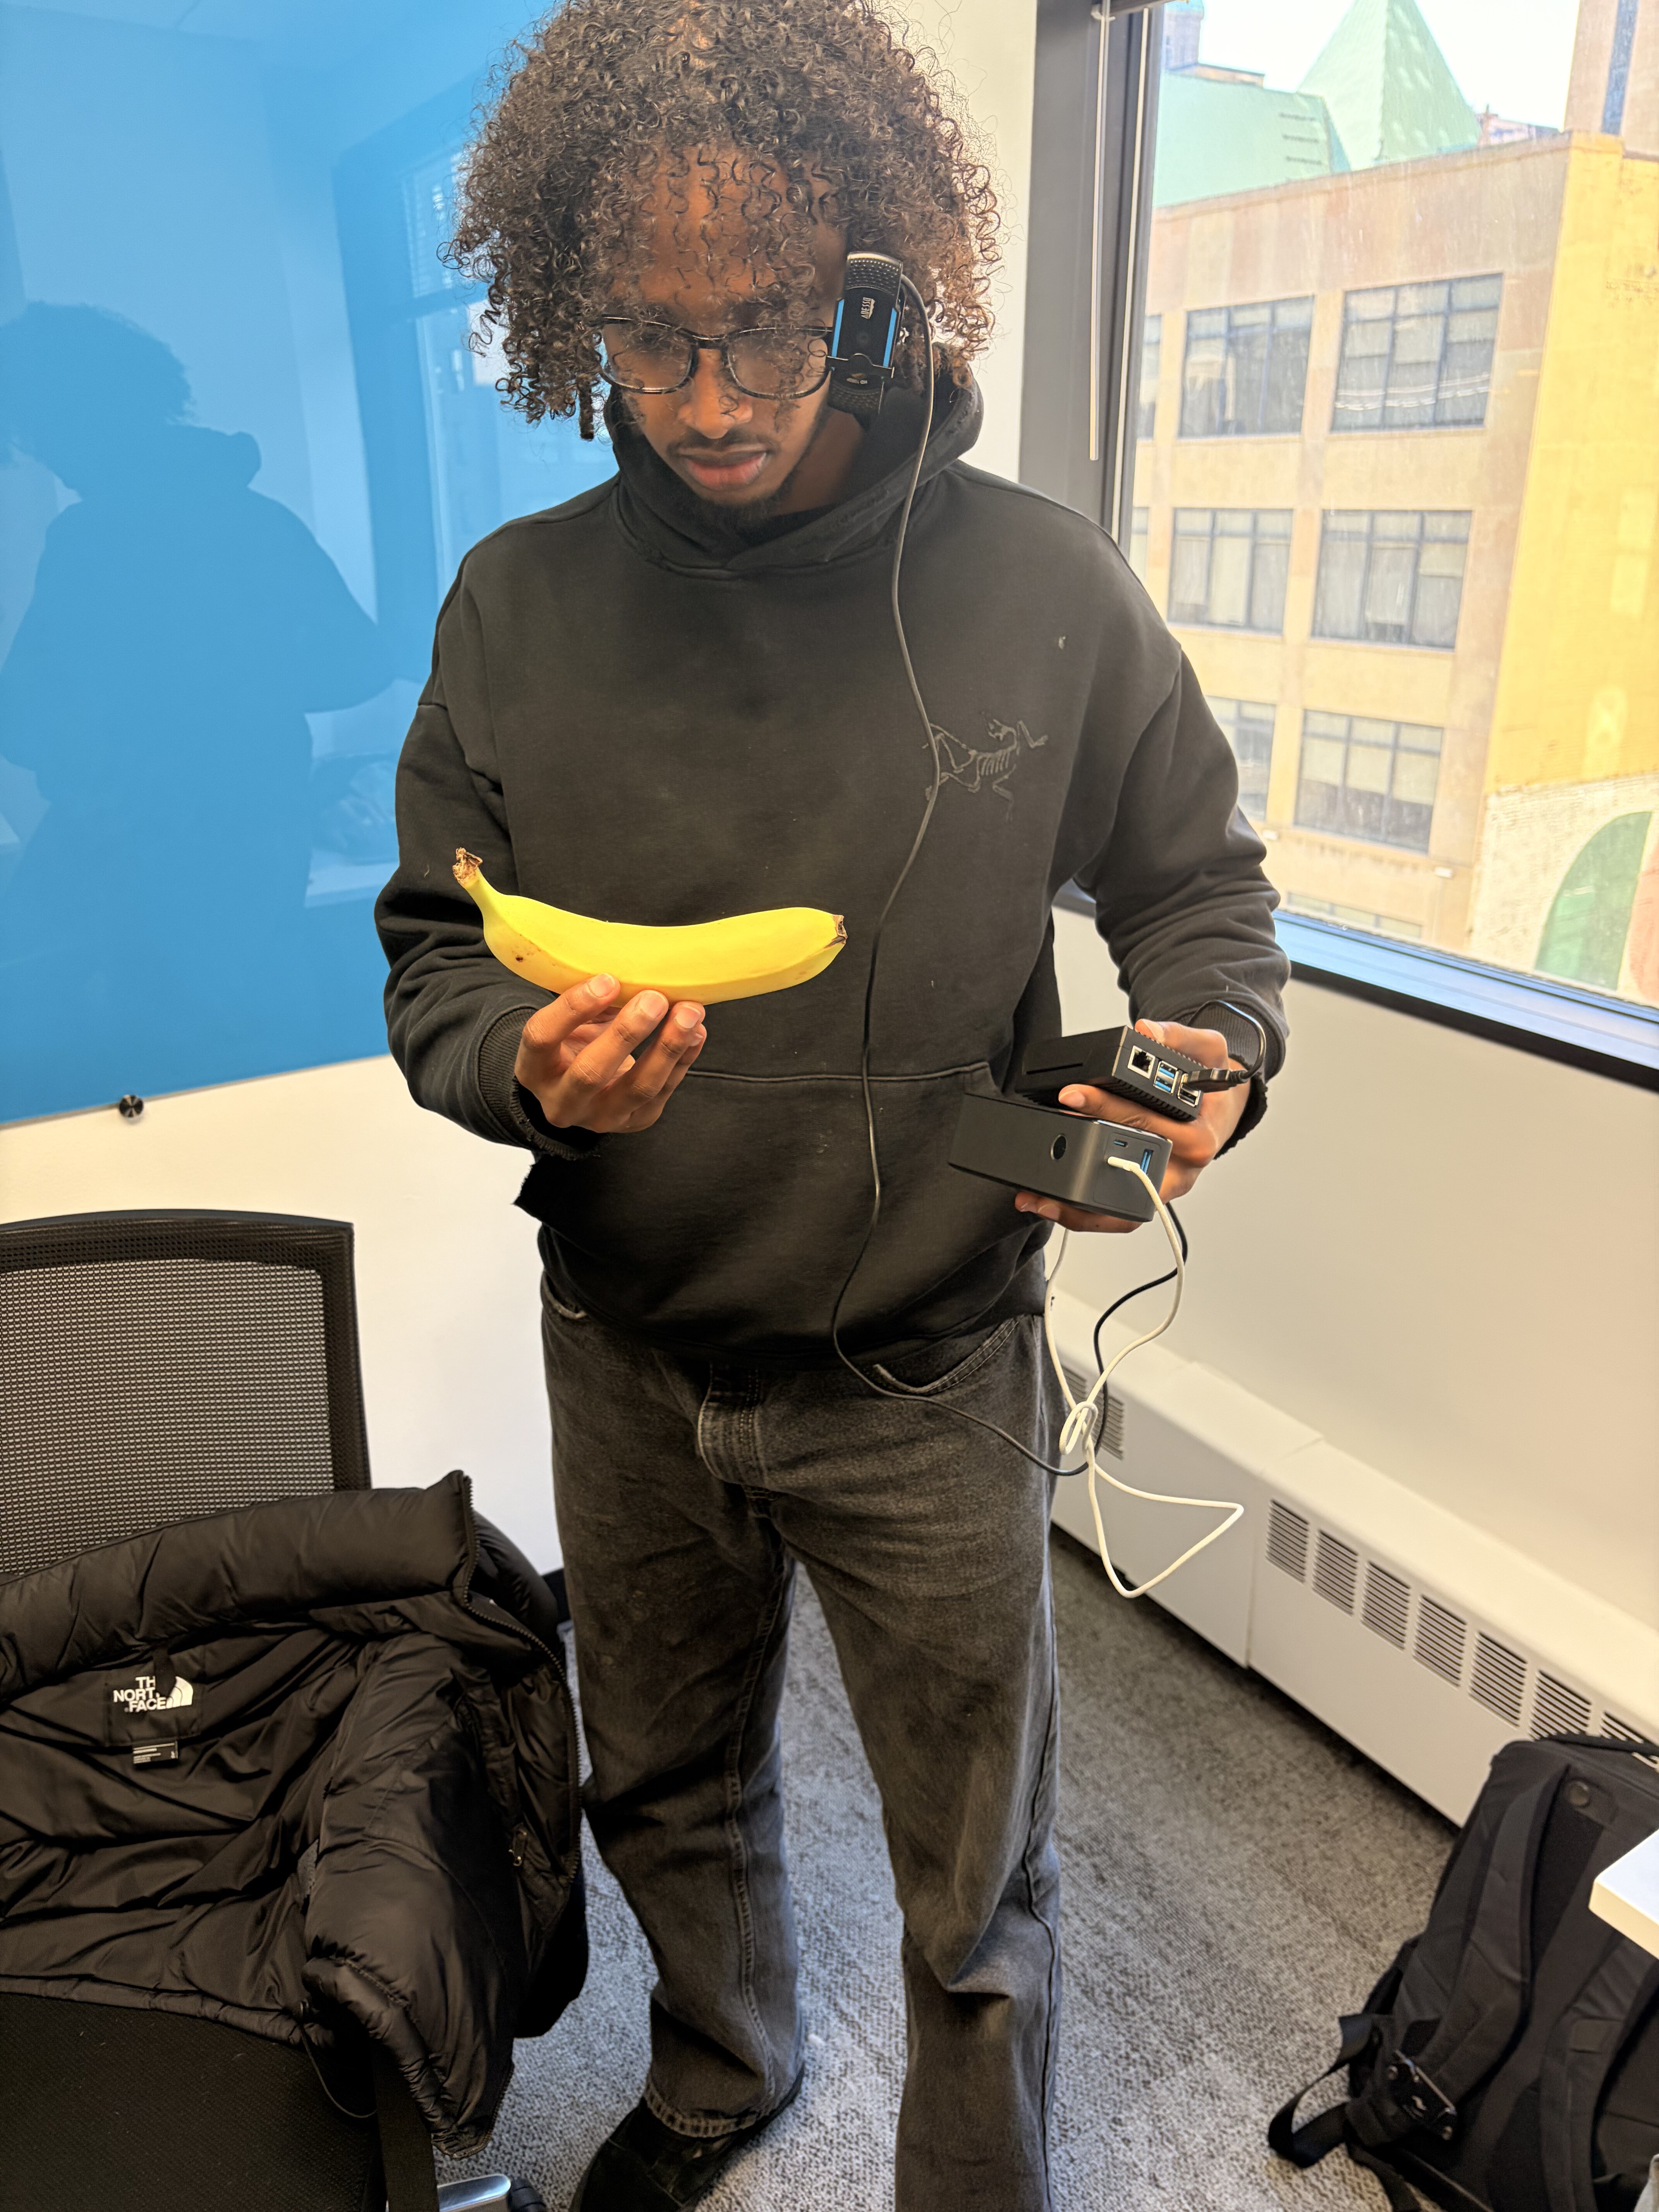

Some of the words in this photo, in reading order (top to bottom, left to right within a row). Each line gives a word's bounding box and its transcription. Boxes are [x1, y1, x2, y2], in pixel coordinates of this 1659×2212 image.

[861, 297, 871, 319] ADESSO
[135, 1676, 156, 1688] TH
[113, 1687, 160, 1702] NORT
[129, 1697, 167, 1712] FACE
